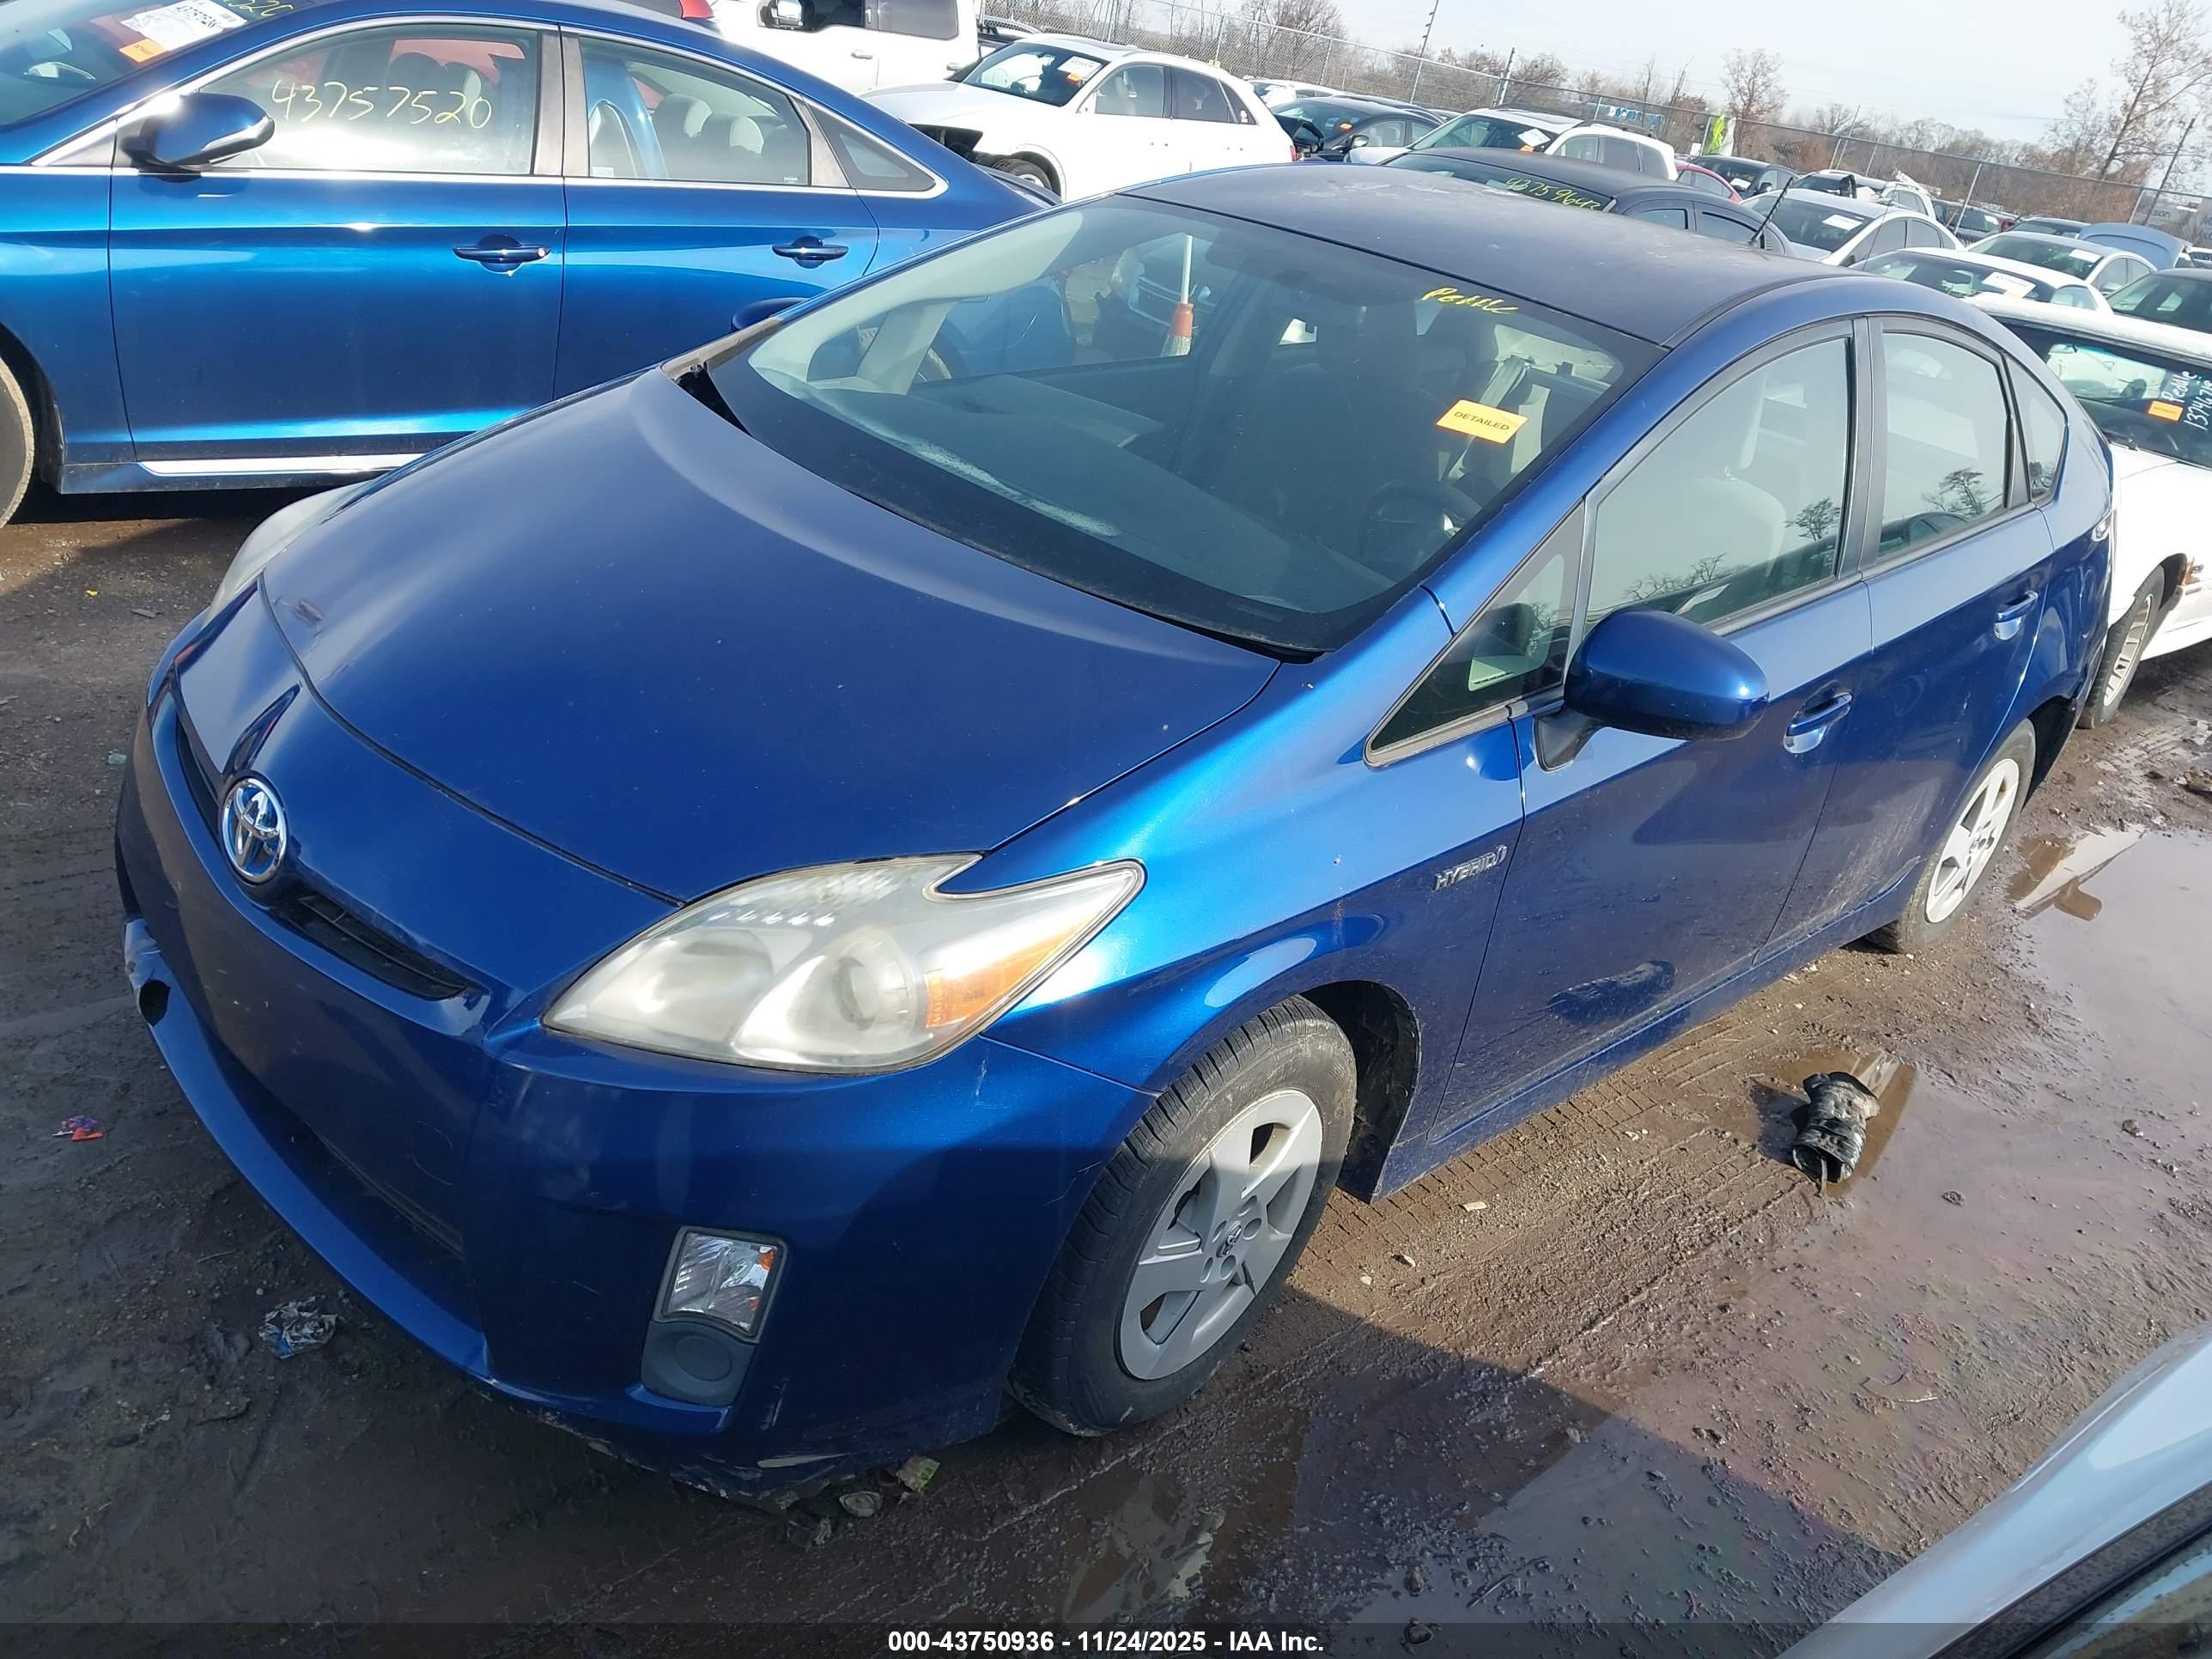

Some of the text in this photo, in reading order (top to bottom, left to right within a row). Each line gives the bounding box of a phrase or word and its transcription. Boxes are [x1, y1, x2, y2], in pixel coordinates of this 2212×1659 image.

[271, 79, 493, 130] 43757520
[2160, 370, 2198, 404] Peddle
[1453, 410, 1511, 433] DETAILED
[1431, 851, 1498, 893] HYBRID
